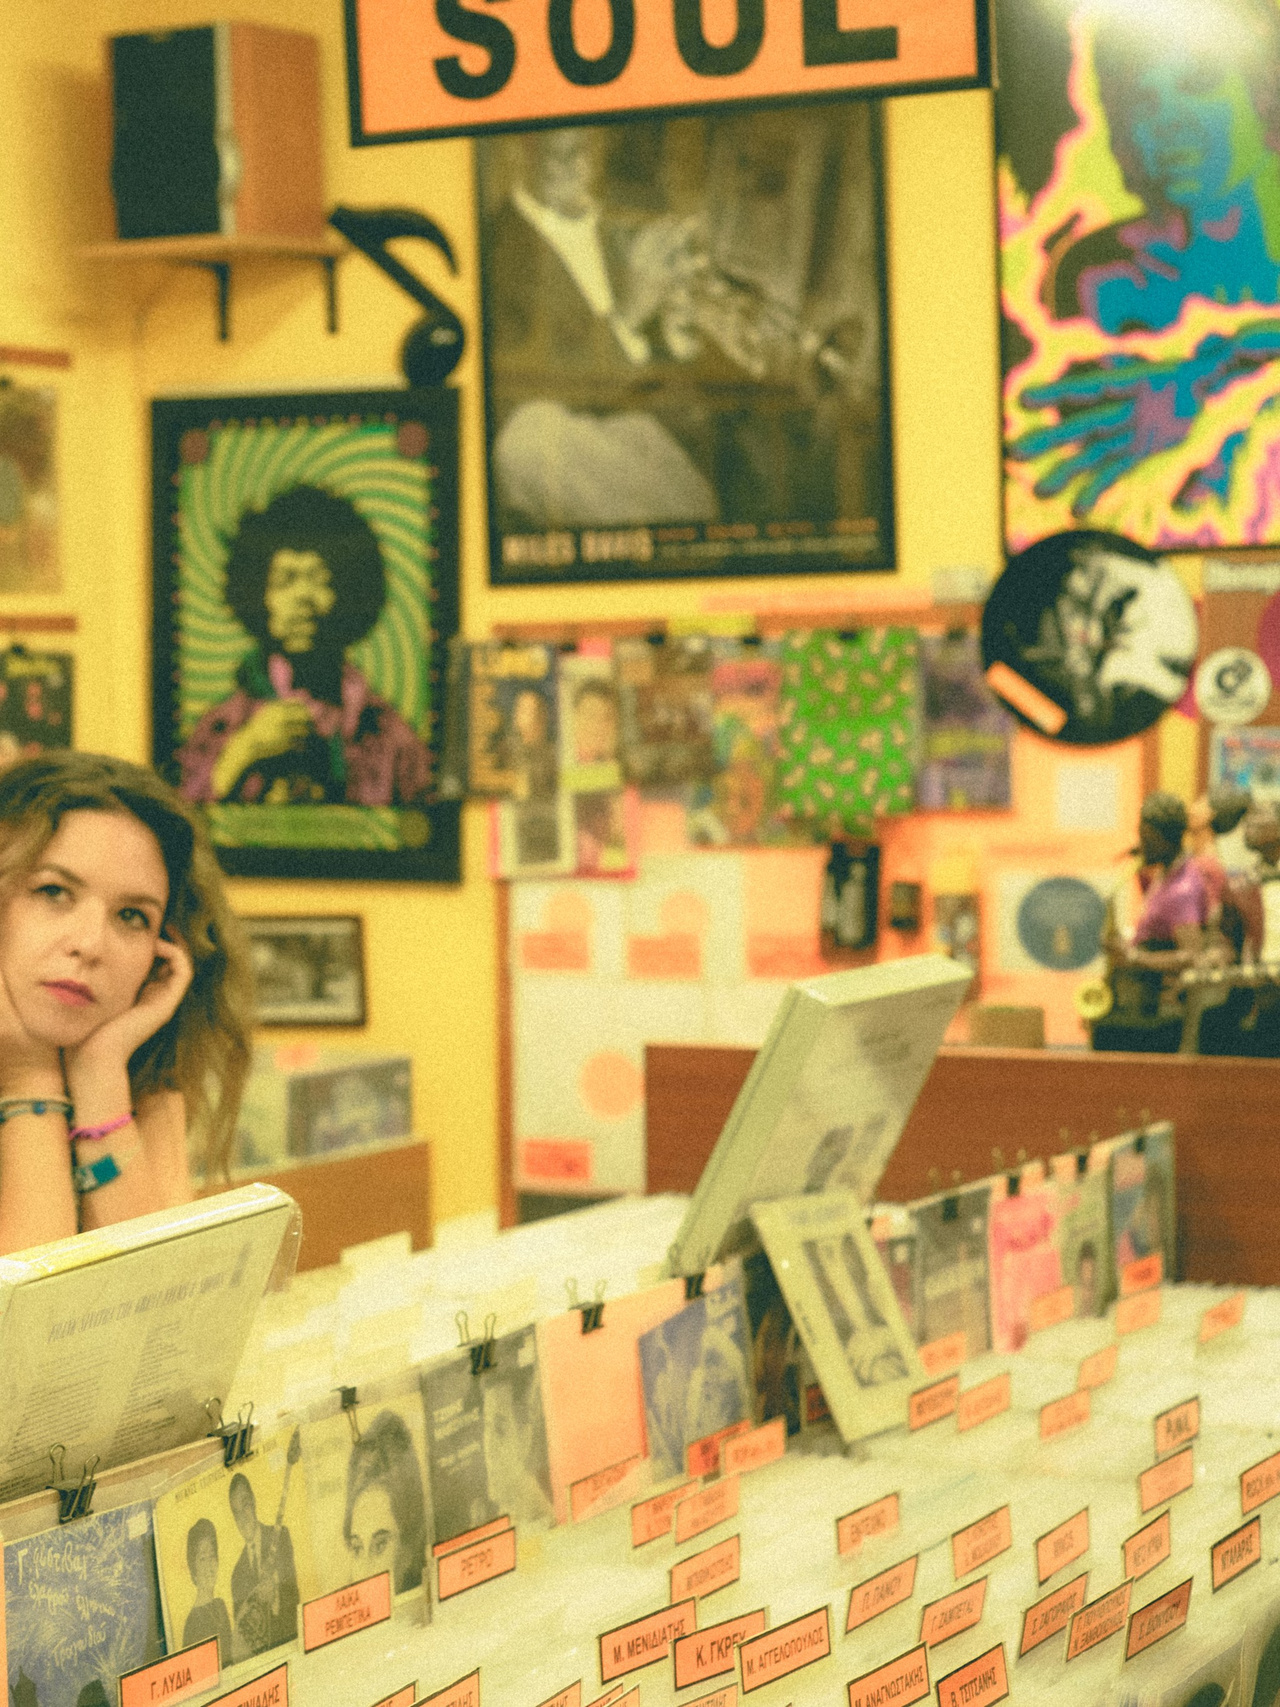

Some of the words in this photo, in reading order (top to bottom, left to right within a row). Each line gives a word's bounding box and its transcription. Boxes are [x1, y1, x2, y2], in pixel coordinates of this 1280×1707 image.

[433, 0, 900, 100] SOUL
[460, 1547, 494, 1578] ΡΕΤΡΟ
[324, 1606, 372, 1636] ΡΕΜΠΕΤΙΚΑ
[613, 1644, 625, 1664] Μ.
[627, 1618, 687, 1659] ΜΕΝΙΔΙΑΤΗΣ
[695, 1644, 707, 1669] Κ.
[746, 1659, 757, 1677] Μ.
[758, 1626, 825, 1671] ΑΓΓΕΛΟΠΟΥΛΟΣ
[150, 1681, 161, 1700] Γ.
[161, 1667, 192, 1696] ΛΥΔΙΑ
[959, 1667, 997, 1705] ΤΣΙΤΣΑΝΗΣ
